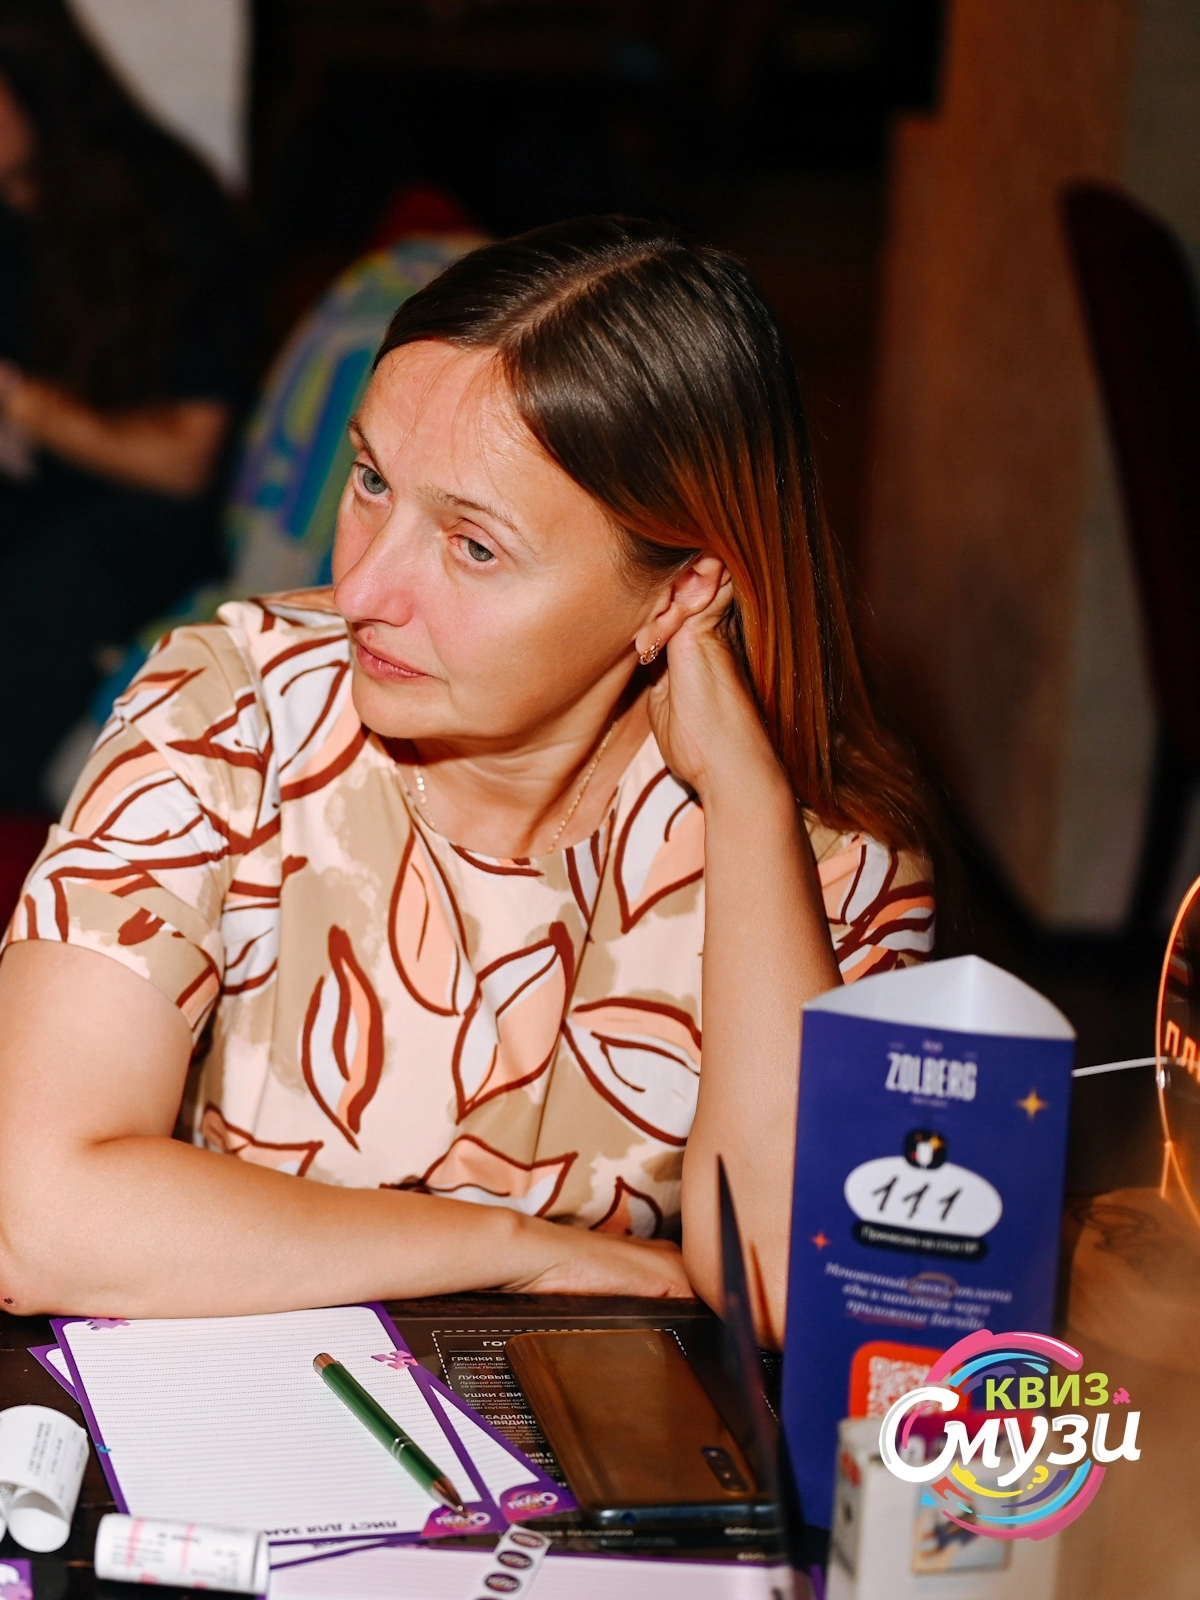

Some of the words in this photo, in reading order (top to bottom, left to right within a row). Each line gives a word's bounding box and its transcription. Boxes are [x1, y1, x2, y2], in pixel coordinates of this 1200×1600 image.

[885, 1052, 978, 1101] ZOLBERG
[307, 1523, 343, 1535] ДЛЯ
[350, 1520, 398, 1530] ЛИСТ
